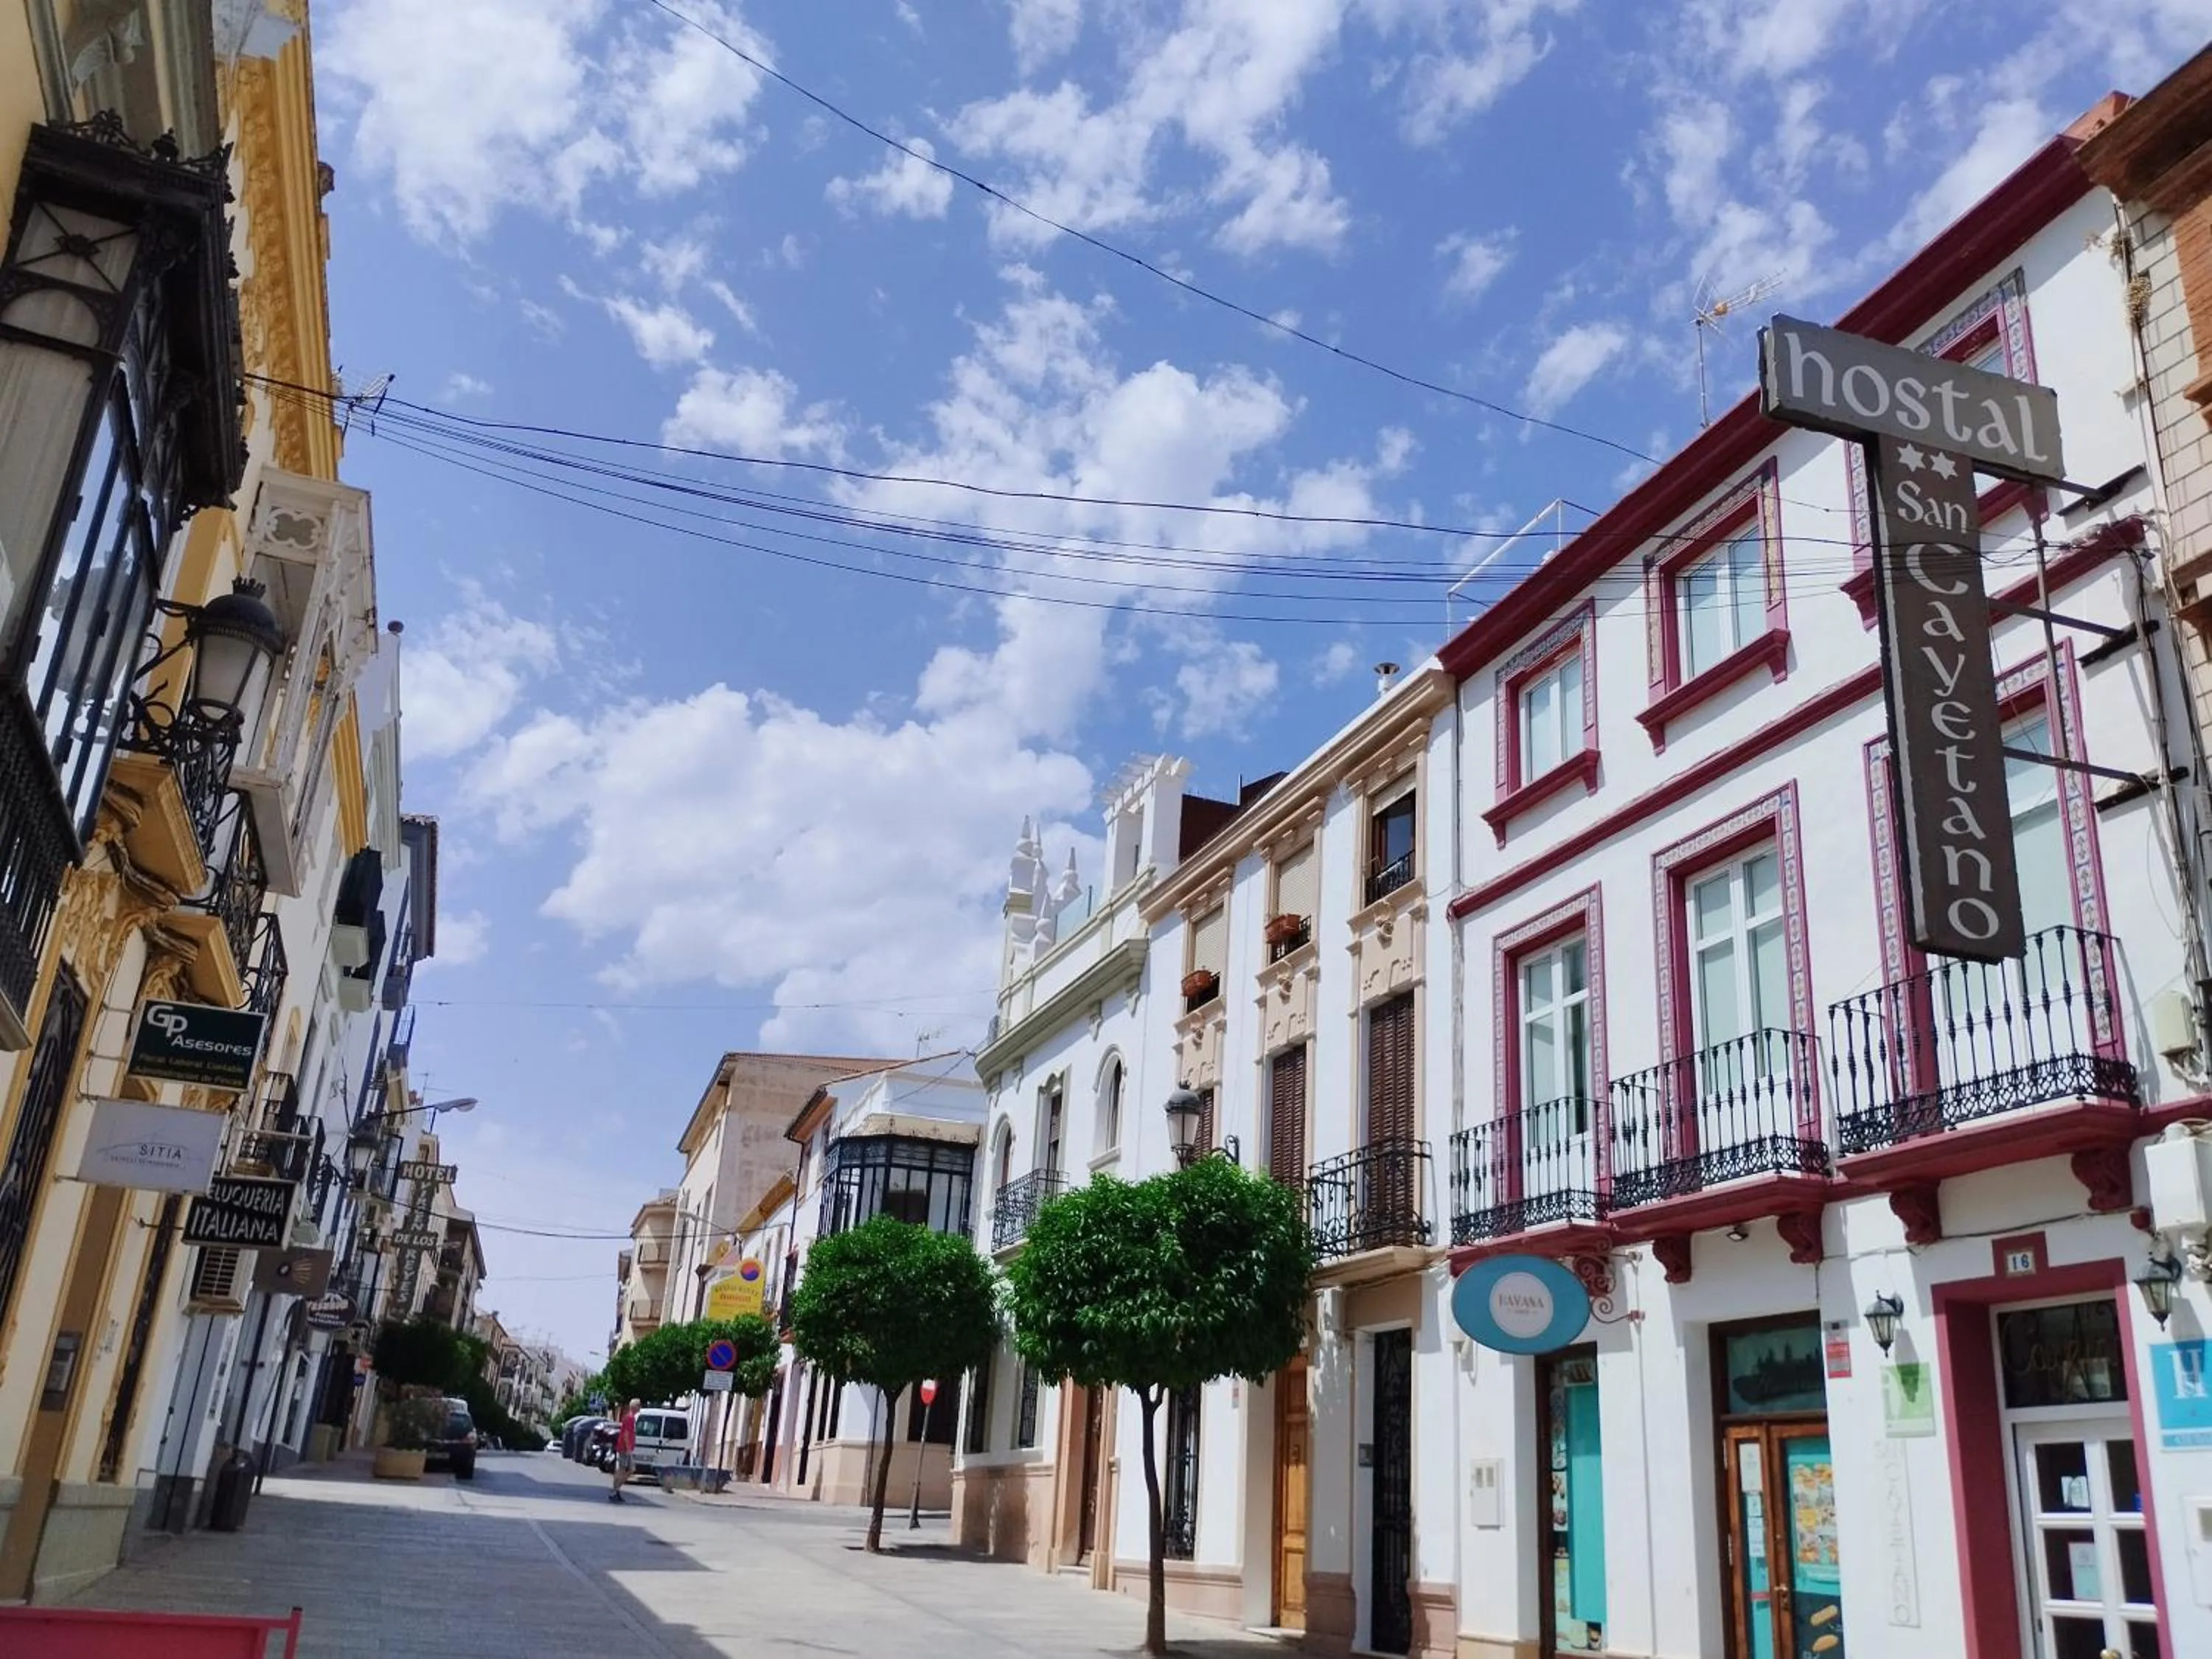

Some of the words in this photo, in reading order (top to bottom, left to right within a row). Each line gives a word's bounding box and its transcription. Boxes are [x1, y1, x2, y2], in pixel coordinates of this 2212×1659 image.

[1783, 332, 2048, 462] hostal
[1896, 479, 1968, 535] San
[1904, 543, 2000, 940] Cayetano
[147, 1004, 189, 1037] GP
[139, 1144, 182, 1161] SITIA
[403, 1164, 456, 1183] HOTEL
[206, 1182, 285, 1216] ELUQUERIA
[190, 1205, 279, 1242] ITALIANA
[394, 1234, 409, 1244] DE
[413, 1234, 434, 1247] LOS
